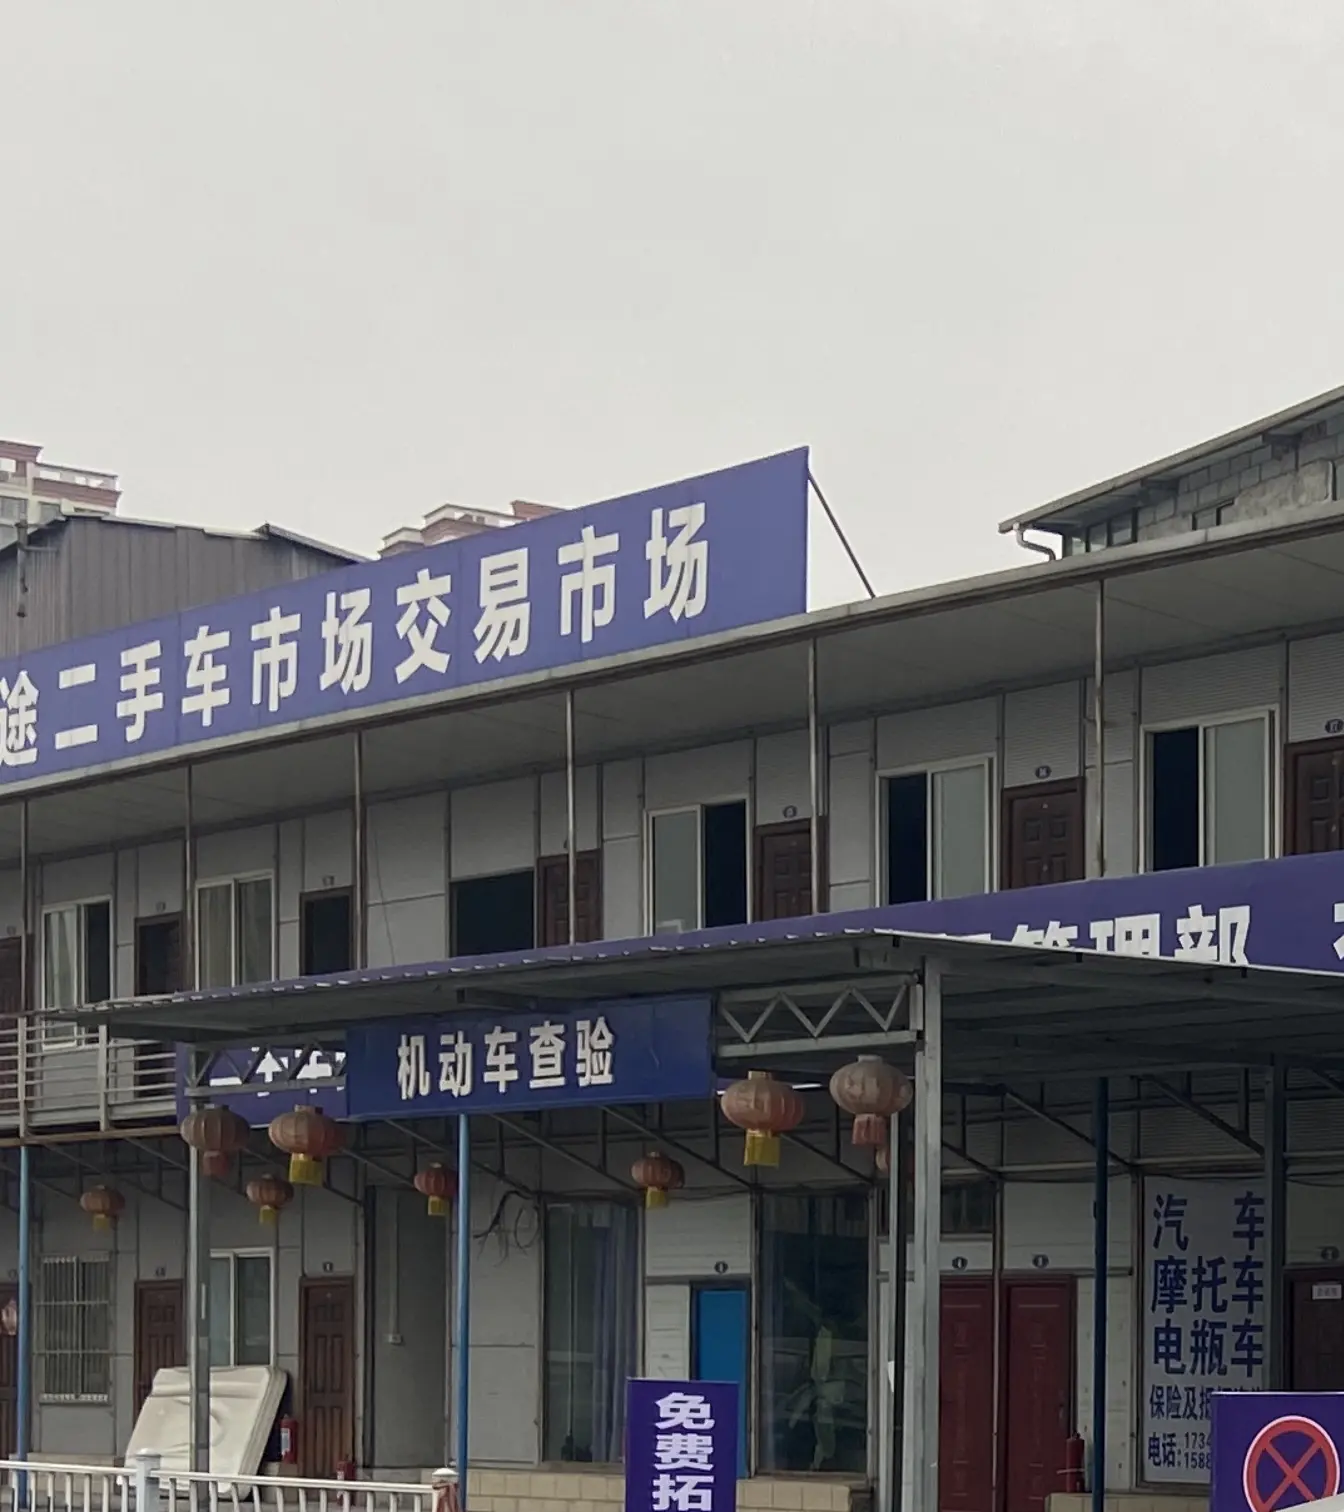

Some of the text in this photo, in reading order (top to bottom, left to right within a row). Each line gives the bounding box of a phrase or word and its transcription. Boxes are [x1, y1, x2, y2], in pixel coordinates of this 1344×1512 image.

[0, 503, 707, 767] 途二手车市场交易市场
[397, 1016, 614, 1101] 机动车查验
[1151, 1254, 1264, 1315] 摩托车
[1152, 1317, 1264, 1378] 电瓶车
